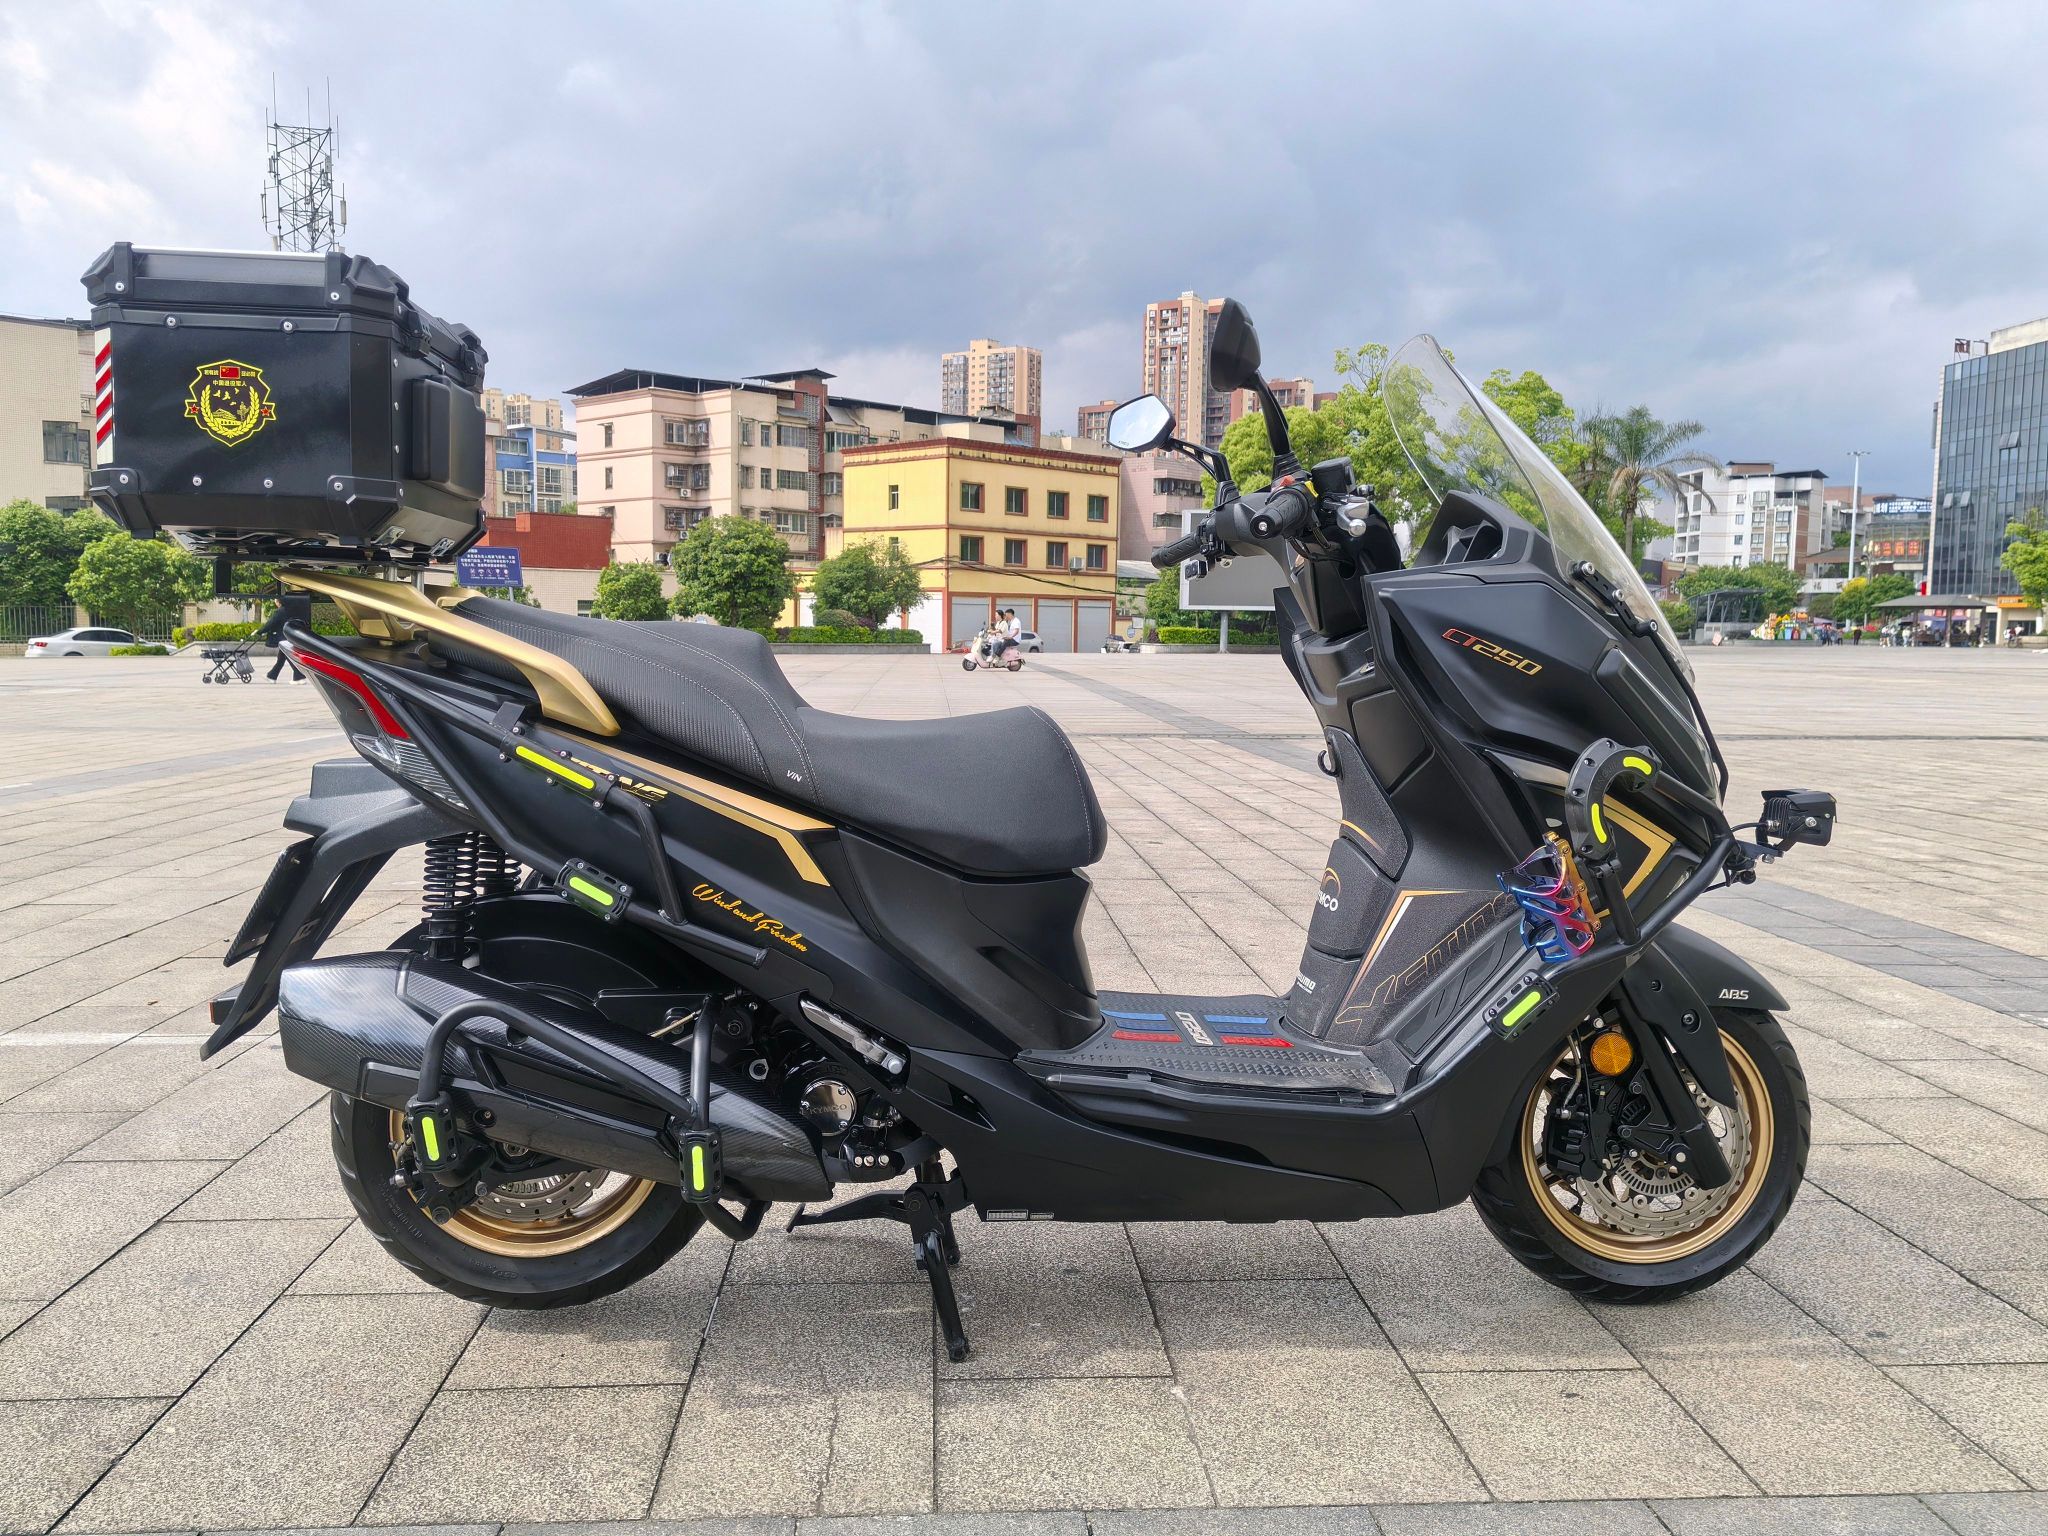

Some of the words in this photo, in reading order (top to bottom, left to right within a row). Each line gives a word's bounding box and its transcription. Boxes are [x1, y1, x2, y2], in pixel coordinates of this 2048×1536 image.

[1442, 628, 1543, 676] CT250
[786, 769, 803, 782] VIN
[692, 883, 742, 911] Wind
[732, 908, 765, 923] and
[753, 919, 808, 952] Freedom
[1718, 988, 1749, 1000] ABS
